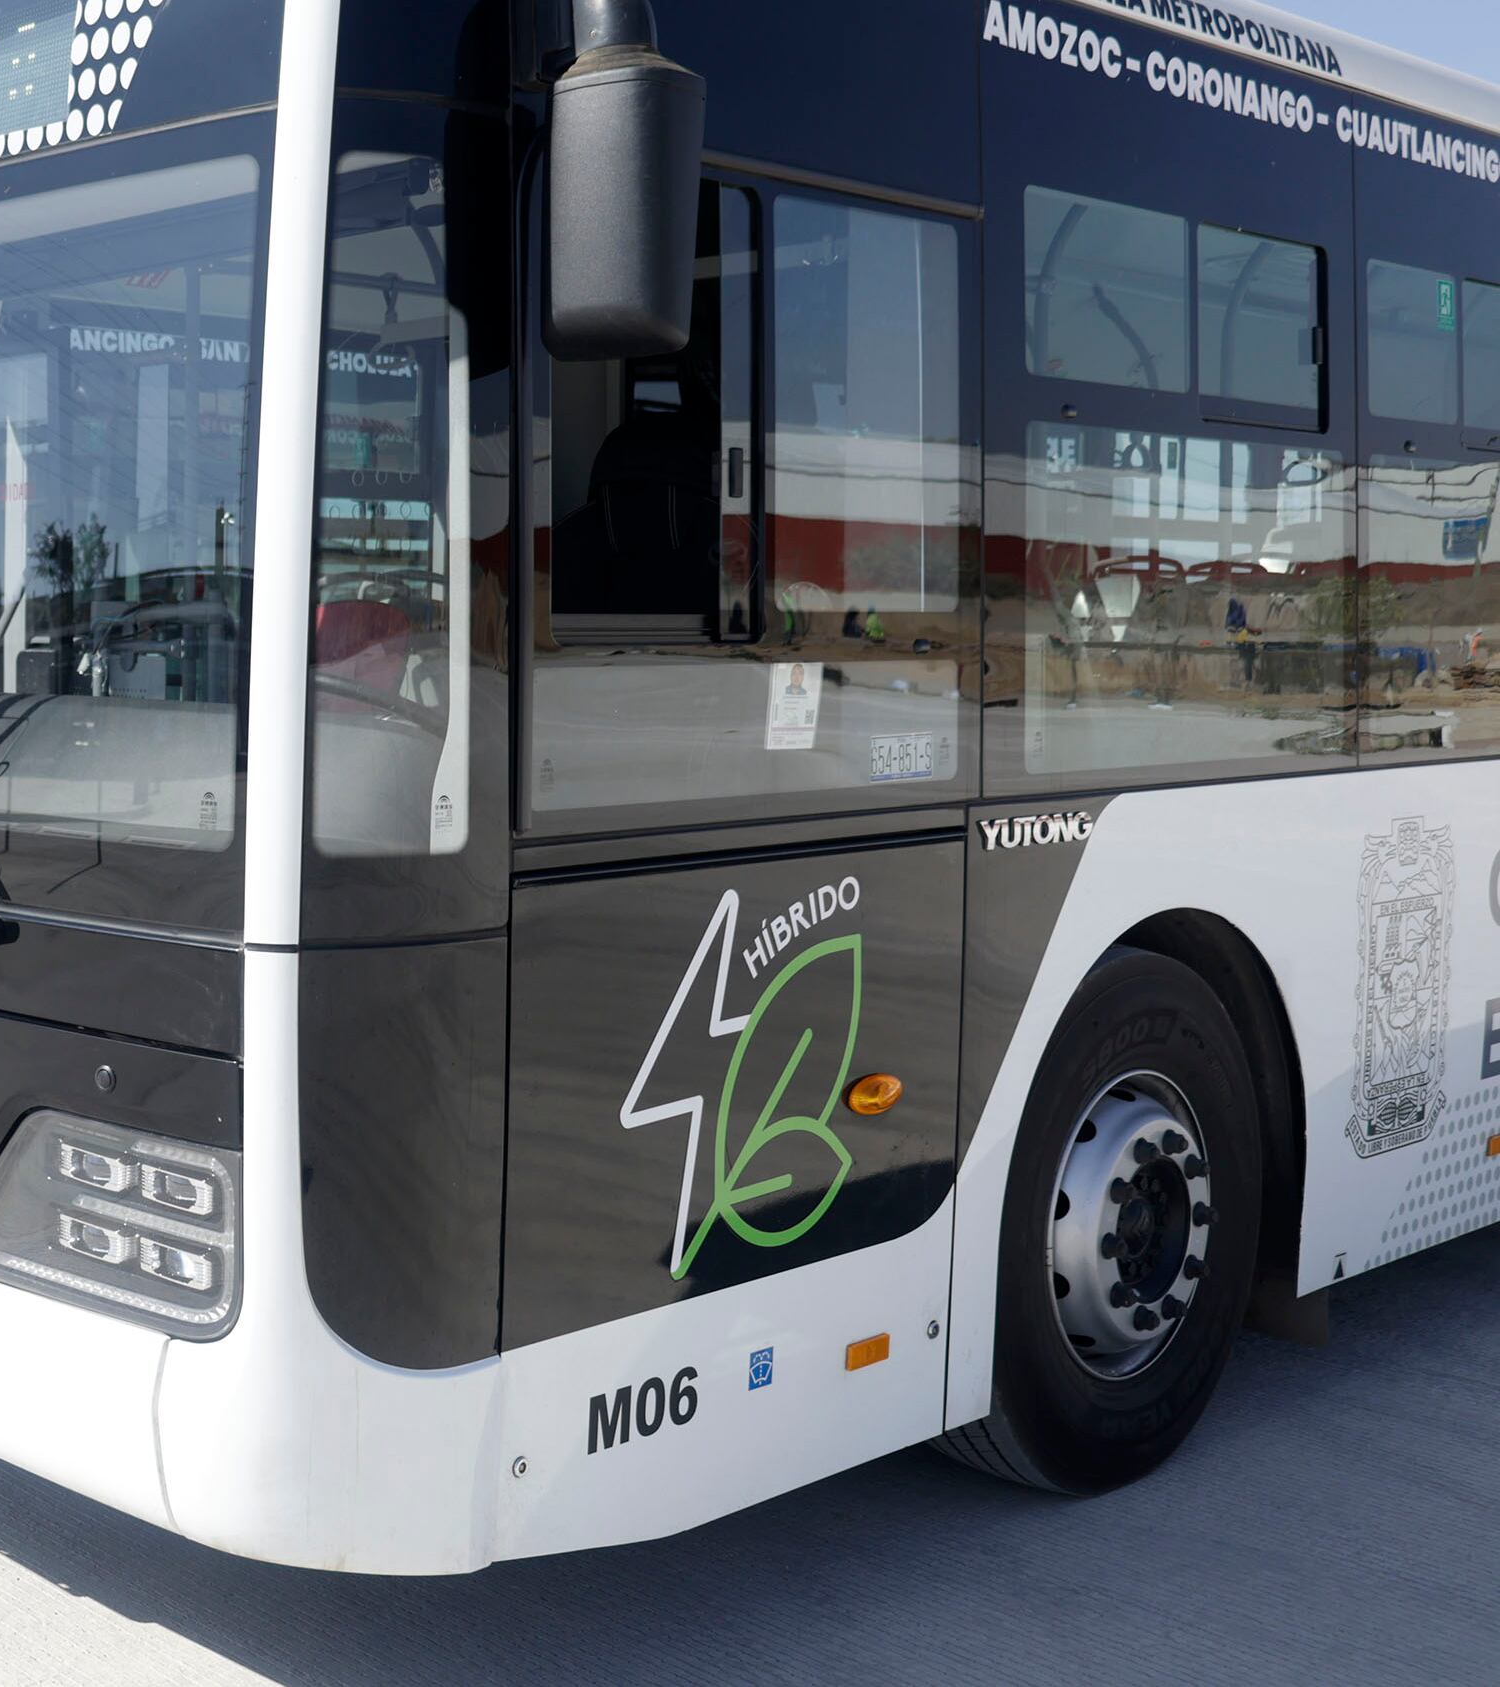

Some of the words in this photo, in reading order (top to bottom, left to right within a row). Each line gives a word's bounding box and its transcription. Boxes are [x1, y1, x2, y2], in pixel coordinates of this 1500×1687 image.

[983, 0, 1122, 78] AMOZOC
[1146, 49, 1314, 133] CORONANGO
[1148, 0, 1343, 77] METROPOLITANA
[870, 742, 932, 775] 654-851-S
[976, 811, 1093, 851] YUTONG
[743, 876, 861, 978] HÍBRIDO
[587, 1365, 699, 1456] M06
